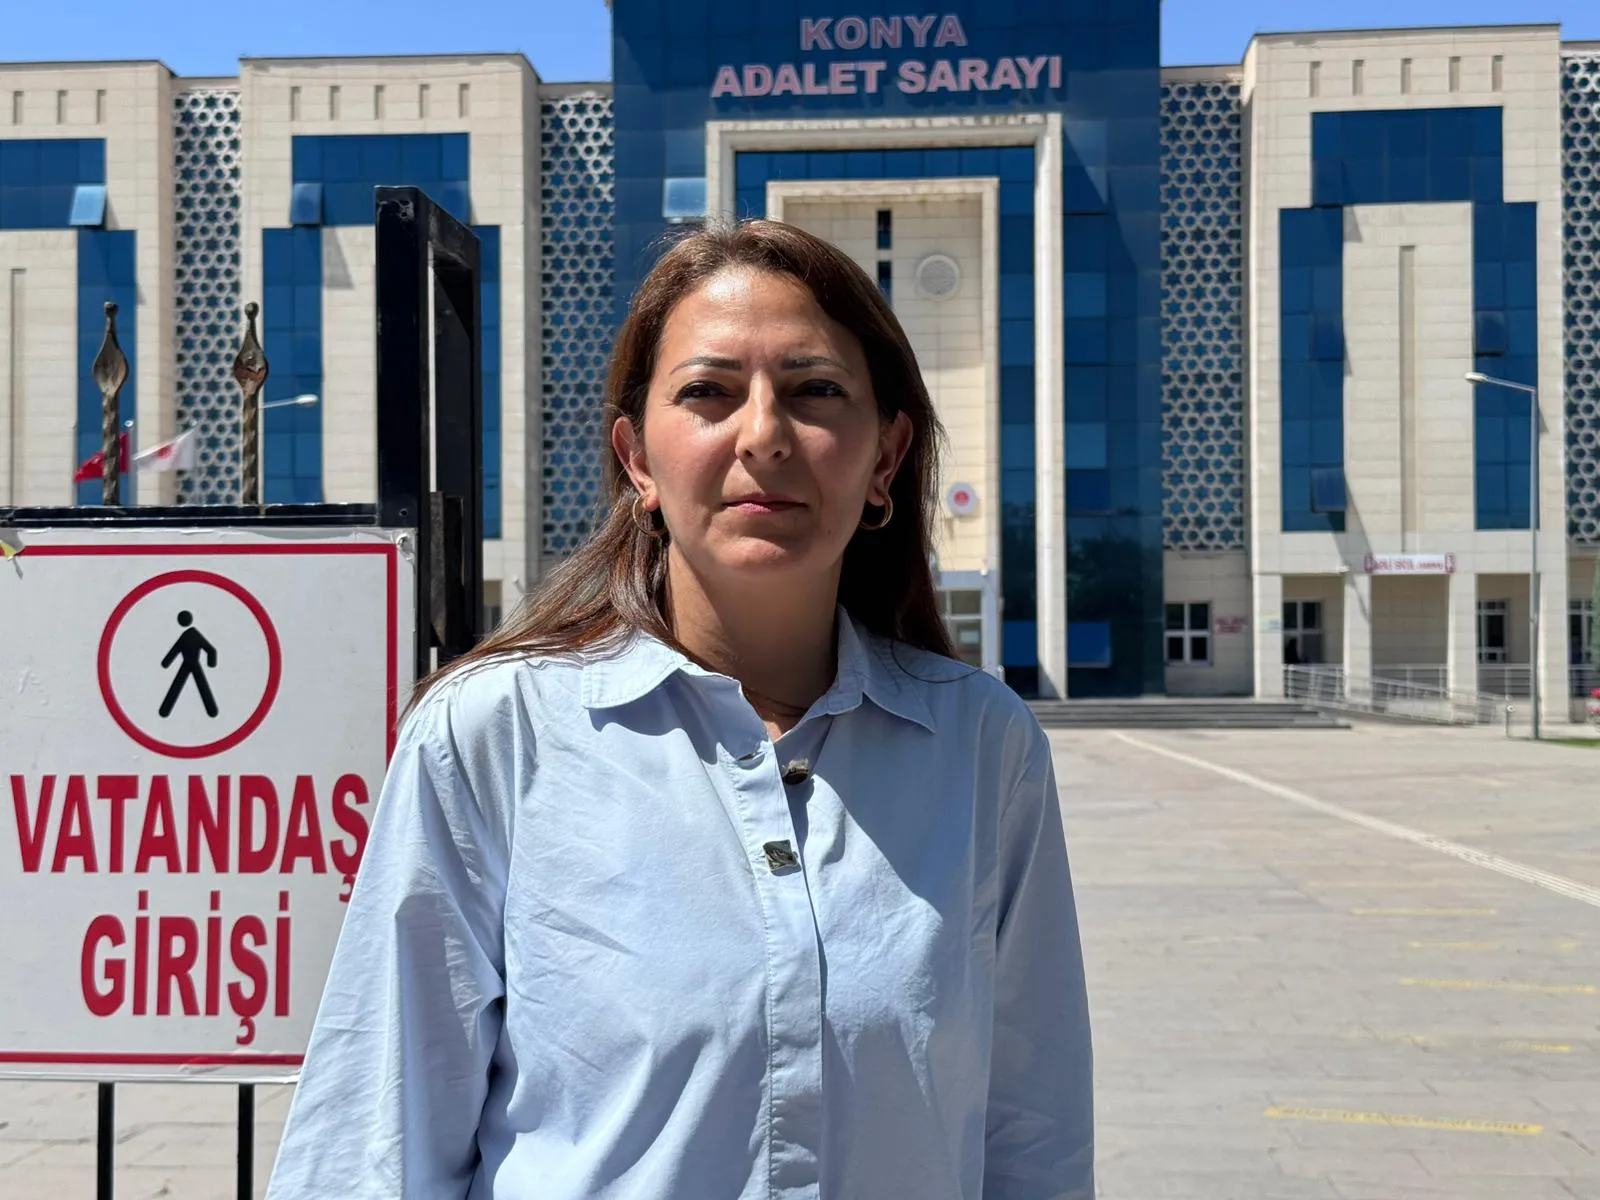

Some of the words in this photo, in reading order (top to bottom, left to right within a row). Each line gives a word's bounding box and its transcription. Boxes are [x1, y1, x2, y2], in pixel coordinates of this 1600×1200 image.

[800, 15, 967, 51] KONYA
[710, 62, 887, 98] ADALET
[898, 56, 1063, 94] SARAYI
[10, 773, 370, 903] VATANDAŞ
[80, 889, 294, 1046] GİRİŞİ
